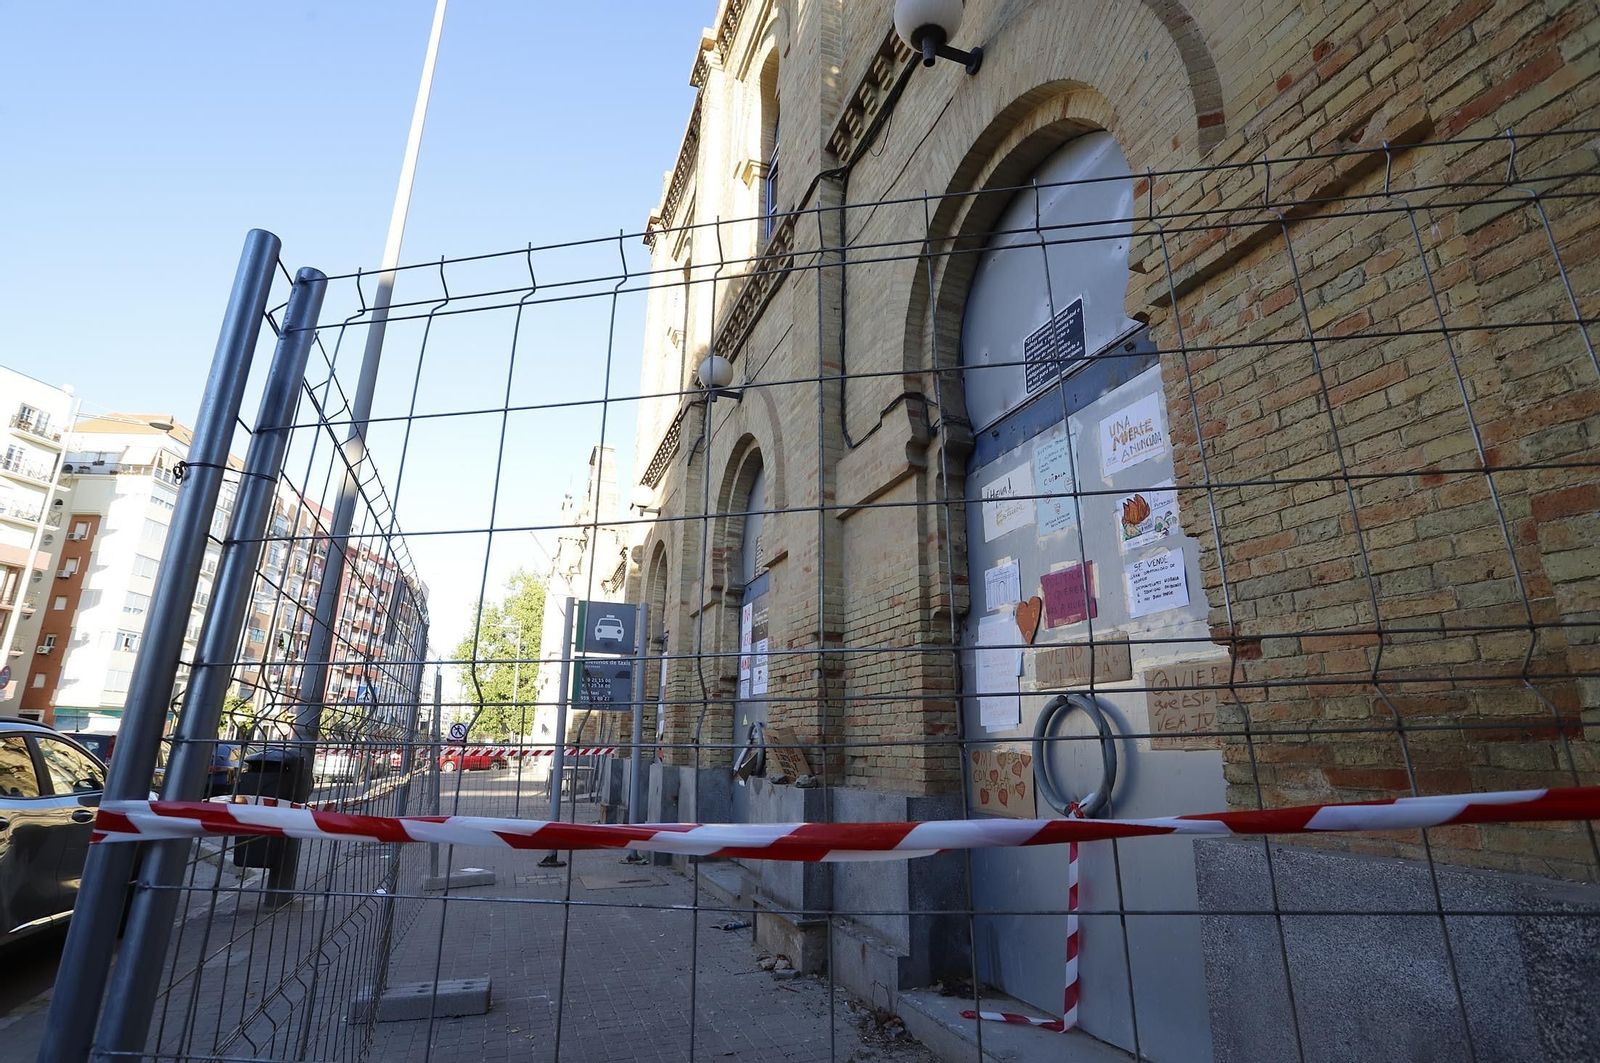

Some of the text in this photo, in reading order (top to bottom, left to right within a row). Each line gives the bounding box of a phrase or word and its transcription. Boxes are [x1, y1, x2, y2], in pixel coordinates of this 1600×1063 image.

[1109, 415, 1130, 438] UNA
[1147, 555, 1168, 567] VENDE
[1151, 666, 1218, 695] QUIER
